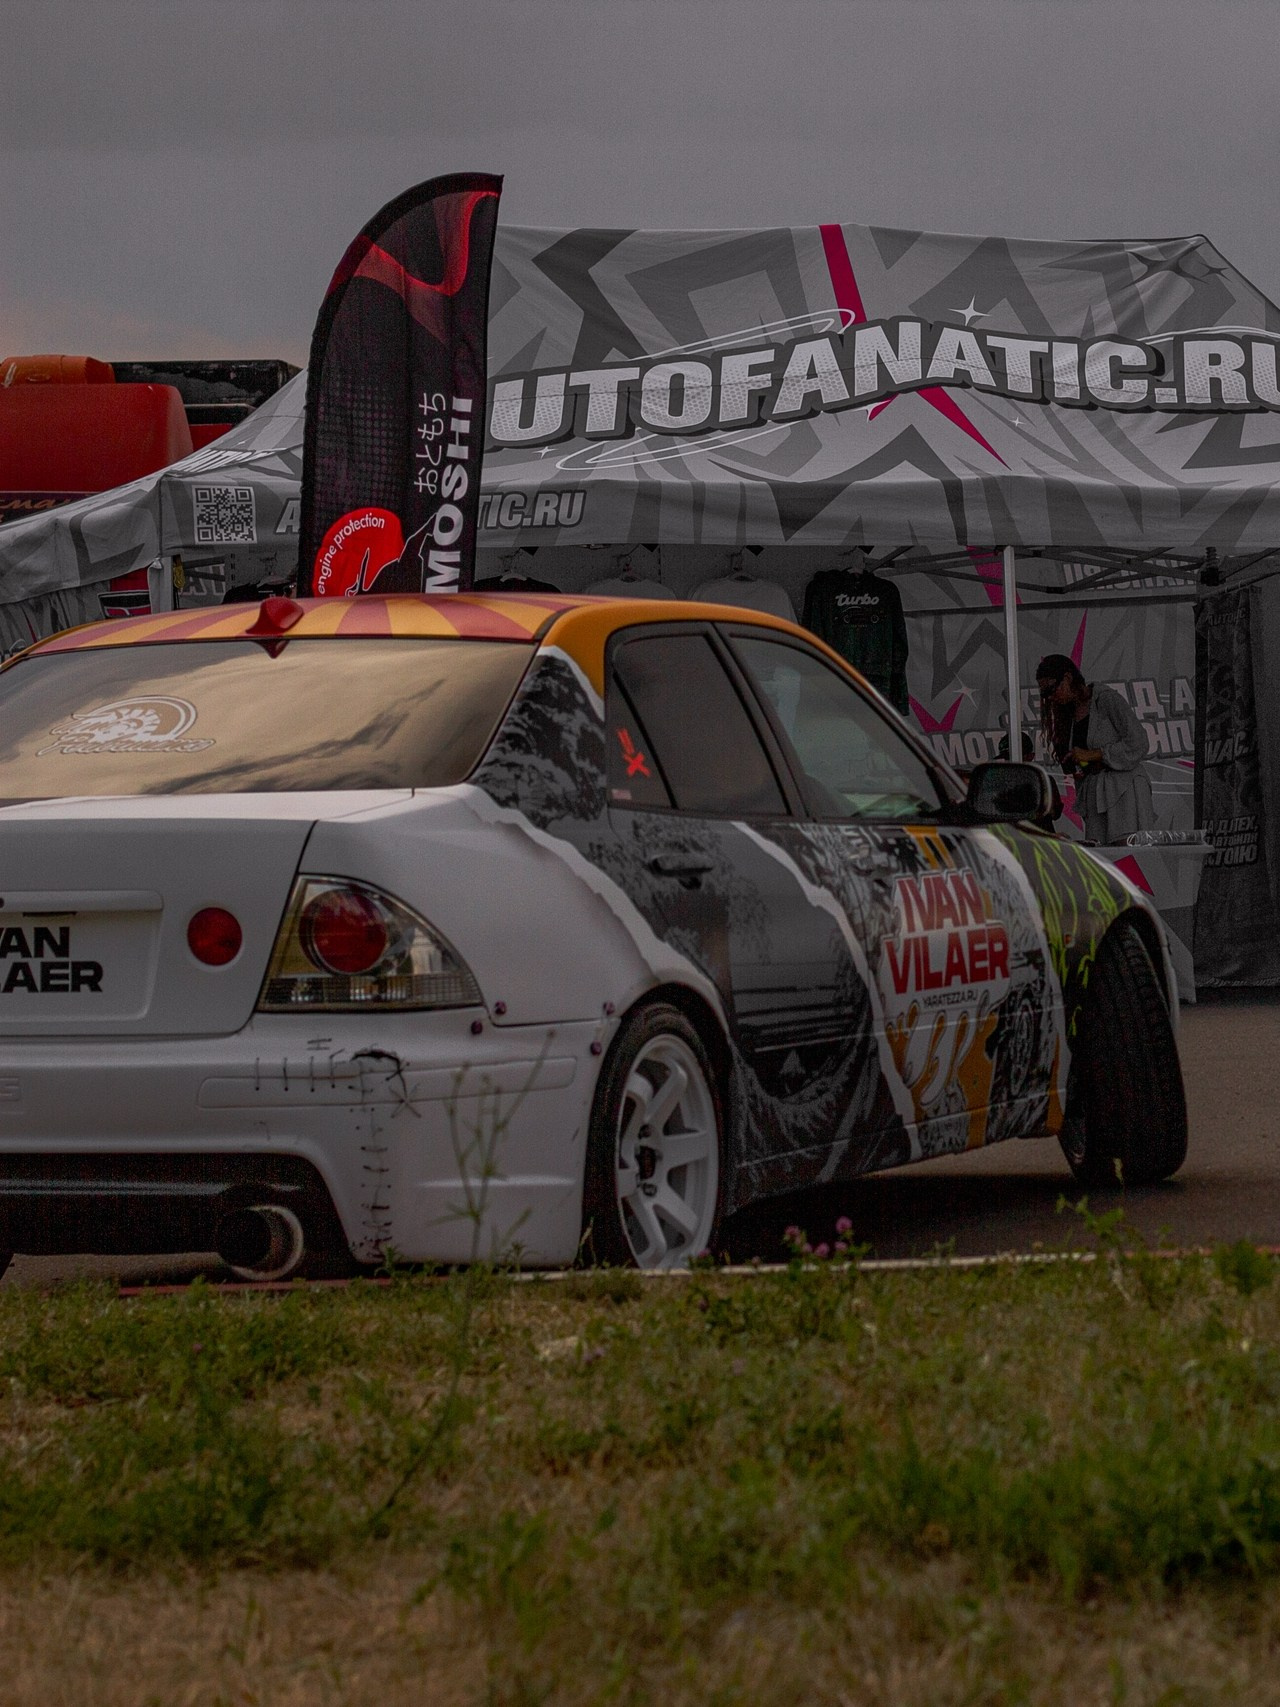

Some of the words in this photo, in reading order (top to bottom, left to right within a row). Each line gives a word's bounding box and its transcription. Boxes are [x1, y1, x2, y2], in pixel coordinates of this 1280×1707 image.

[318, 545, 337, 594] engine
[333, 512, 385, 549] protection
[835, 593, 880, 606] turbo
[898, 873, 985, 933] IVAN
[885, 925, 1009, 995] VILAER
